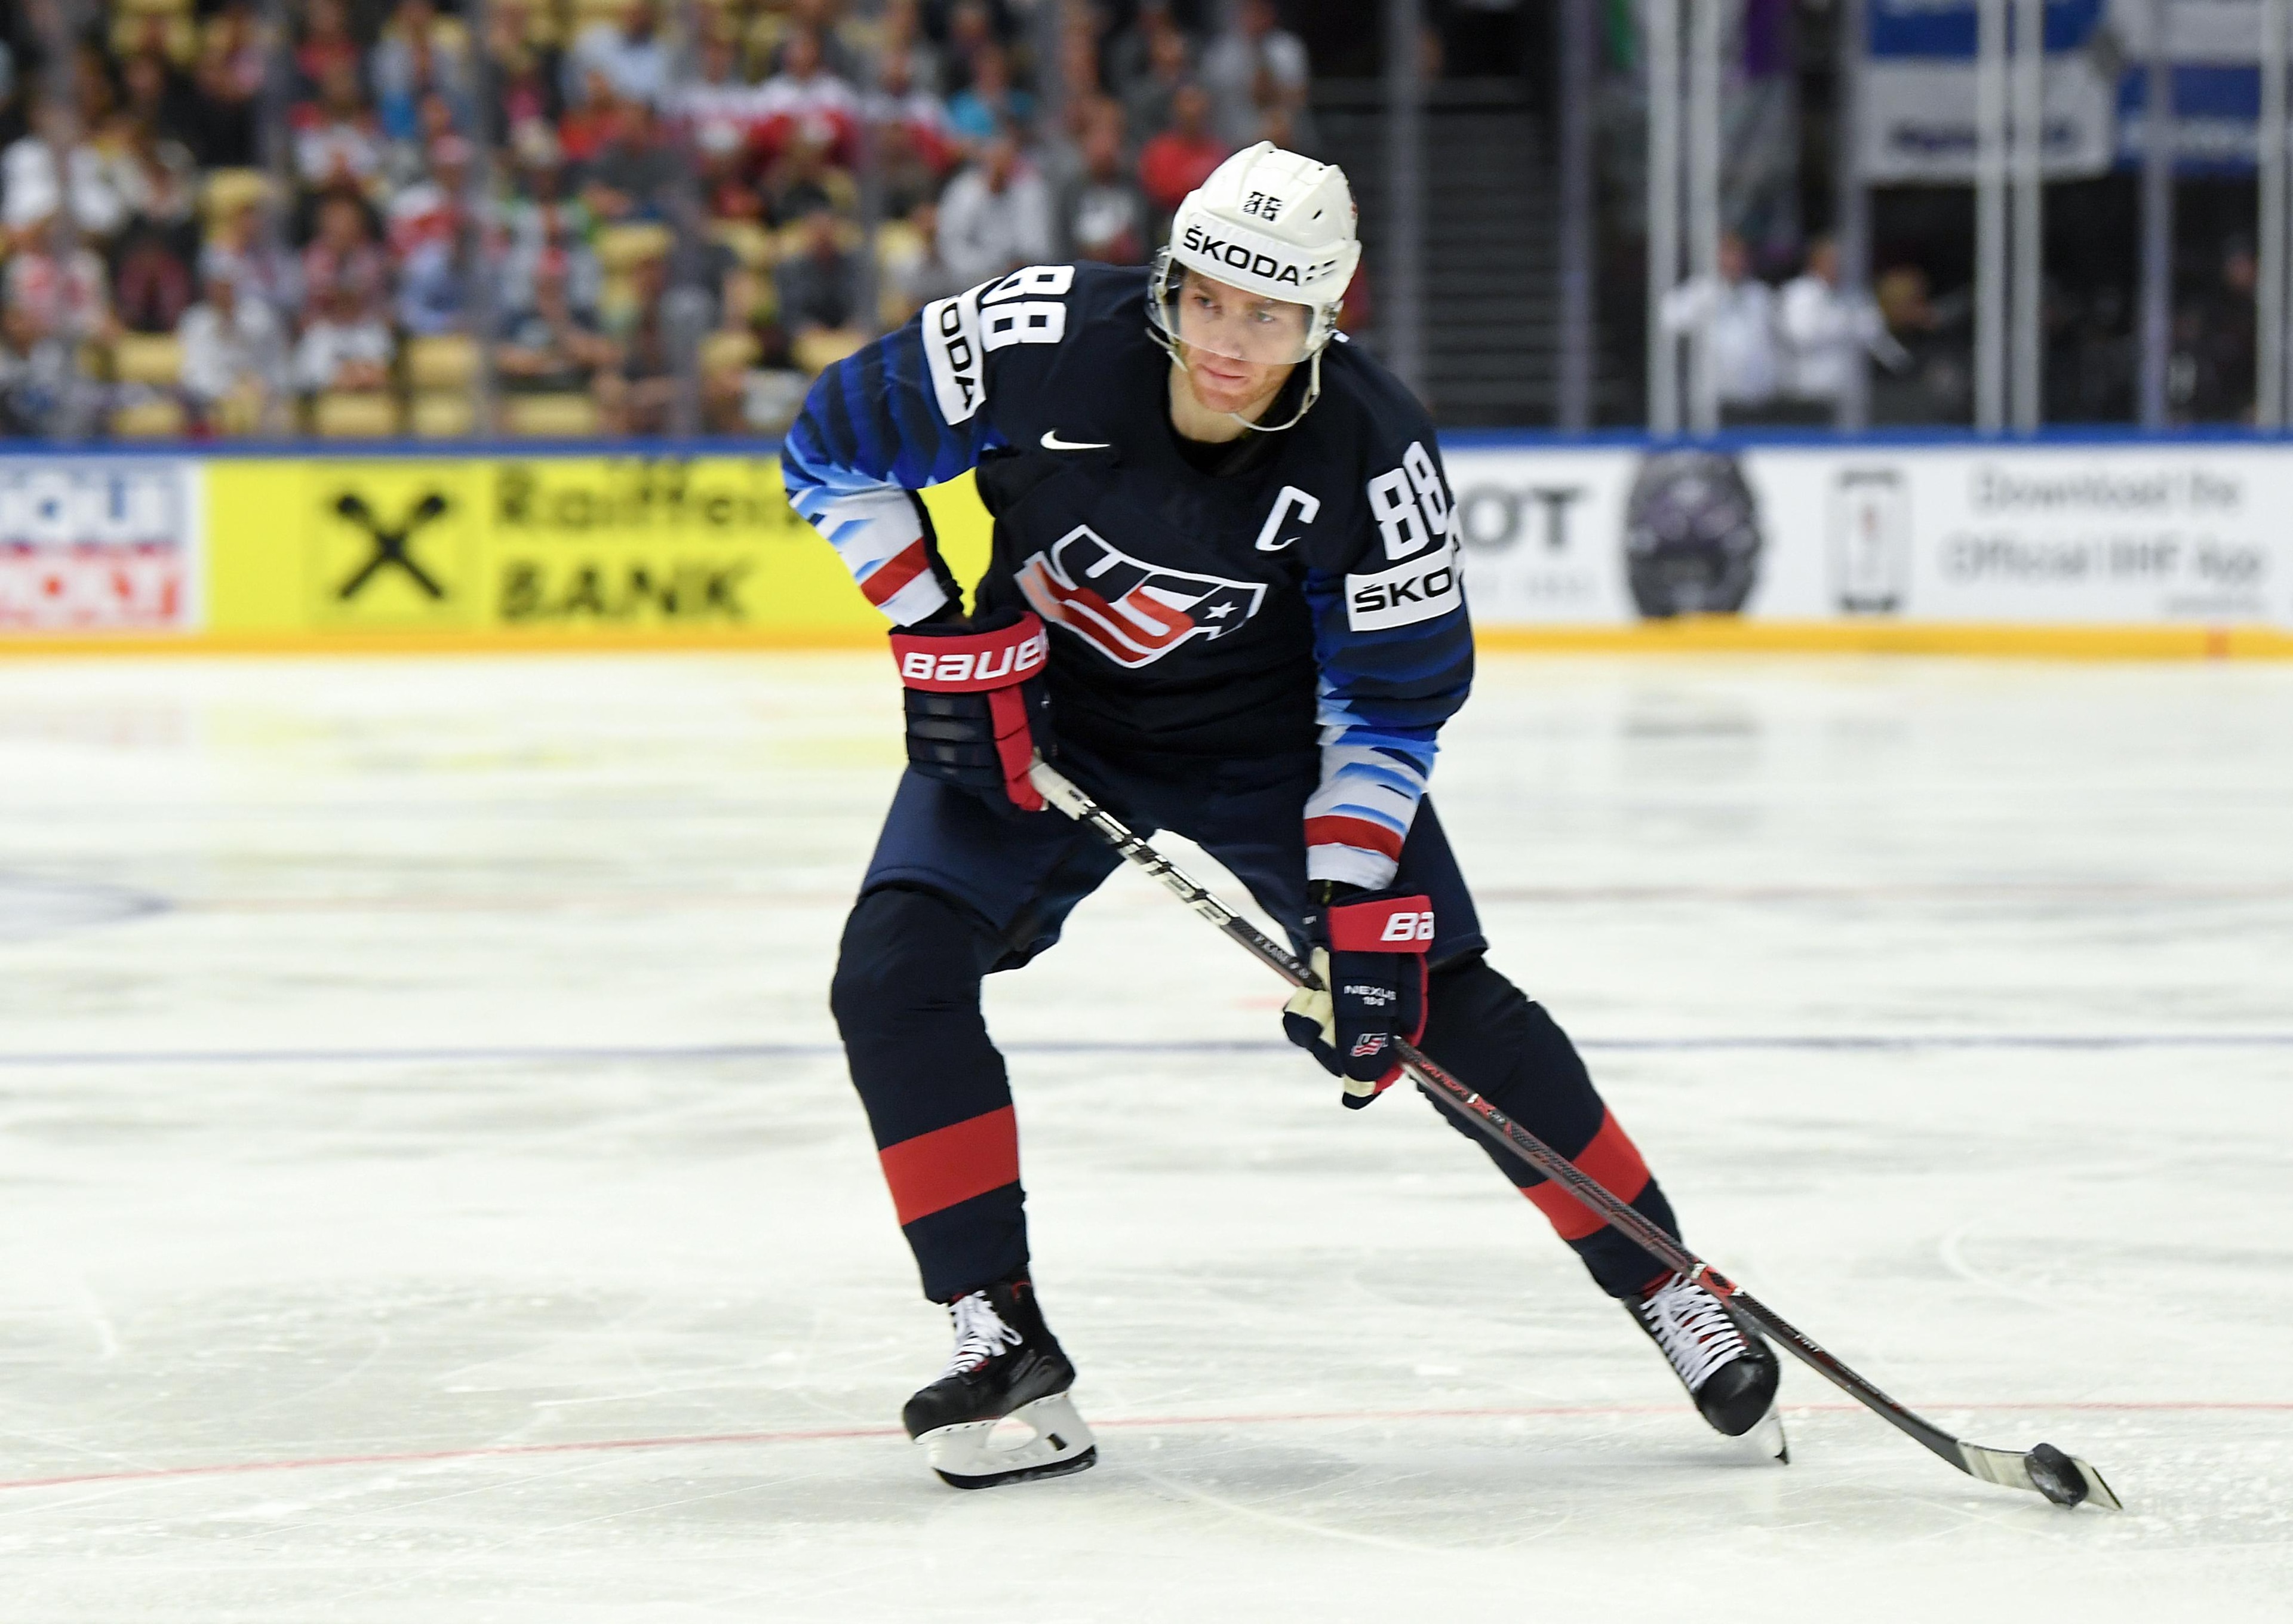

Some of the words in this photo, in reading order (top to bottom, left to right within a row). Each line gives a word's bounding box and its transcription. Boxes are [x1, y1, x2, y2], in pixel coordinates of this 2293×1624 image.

[1183, 224, 1299, 286] ŠKODA
[980, 265, 1075, 352] 88
[940, 301, 975, 411] ODA
[1255, 485, 1320, 551] C
[1367, 441, 1447, 560] 88
[499, 559, 754, 620] BANK
[1355, 562, 1453, 613] ŠKO
